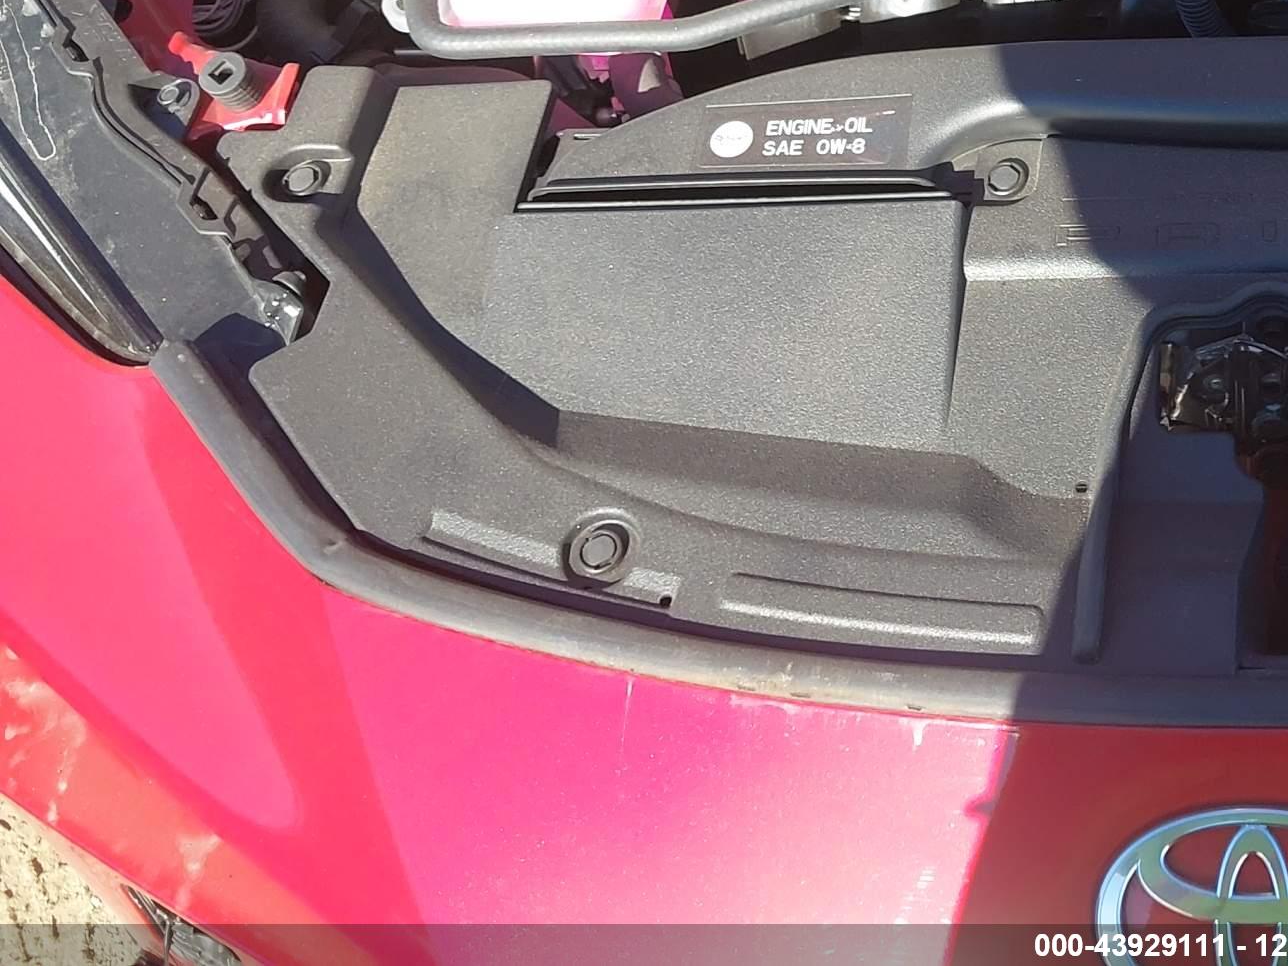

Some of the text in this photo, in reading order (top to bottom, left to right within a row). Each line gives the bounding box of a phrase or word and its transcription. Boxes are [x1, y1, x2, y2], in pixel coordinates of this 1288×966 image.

[765, 117, 873, 136] ENGINE OIL
[762, 140, 804, 156] SAE
